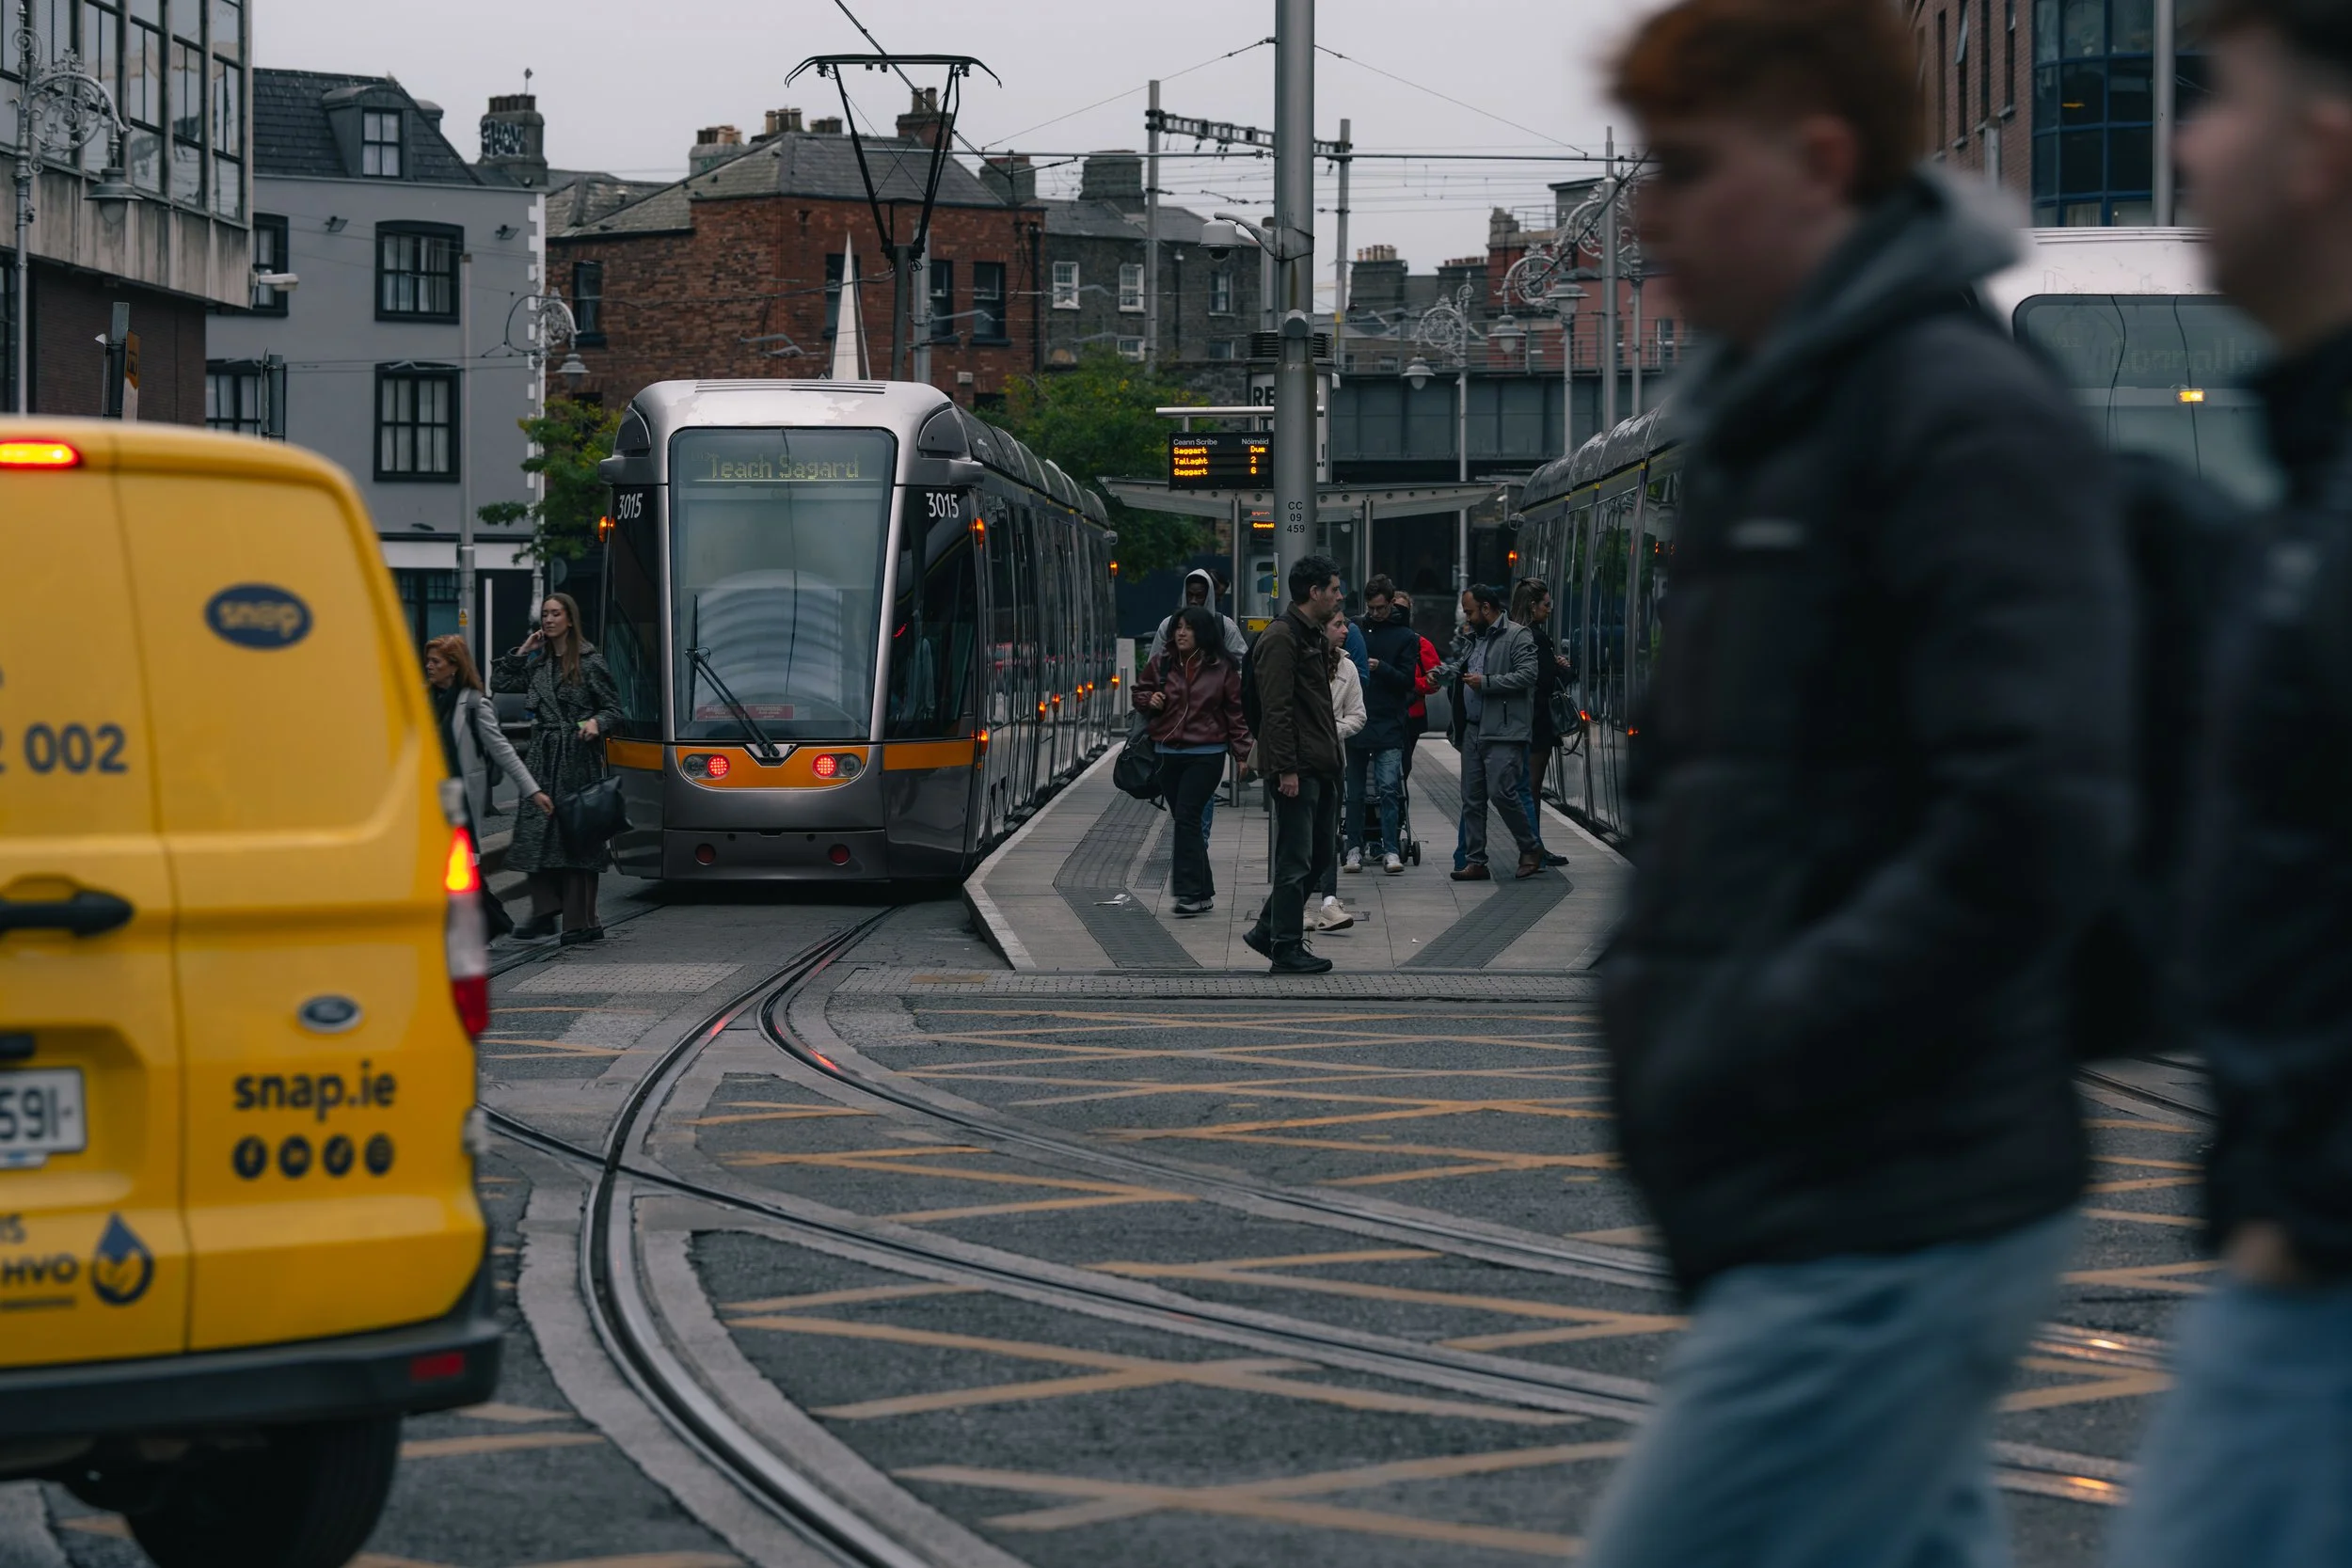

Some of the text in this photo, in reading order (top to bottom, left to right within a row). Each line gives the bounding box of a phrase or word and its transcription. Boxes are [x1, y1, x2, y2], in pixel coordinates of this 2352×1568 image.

[1253, 387, 1275, 406] RE
[1173, 446, 1208, 454] Saggart
[708, 453, 772, 478] Teach
[1173, 457, 1208, 466] Tallaght
[617, 493, 644, 520] 3015
[926, 492, 960, 518] 3015
[1287, 501, 1303, 510] CC
[1286, 524, 1306, 533] 459
[1290, 513, 1302, 522] 09
[218, 601, 301, 639] snap
[24, 721, 129, 774] 002
[233, 1058, 396, 1123] snap.ie
